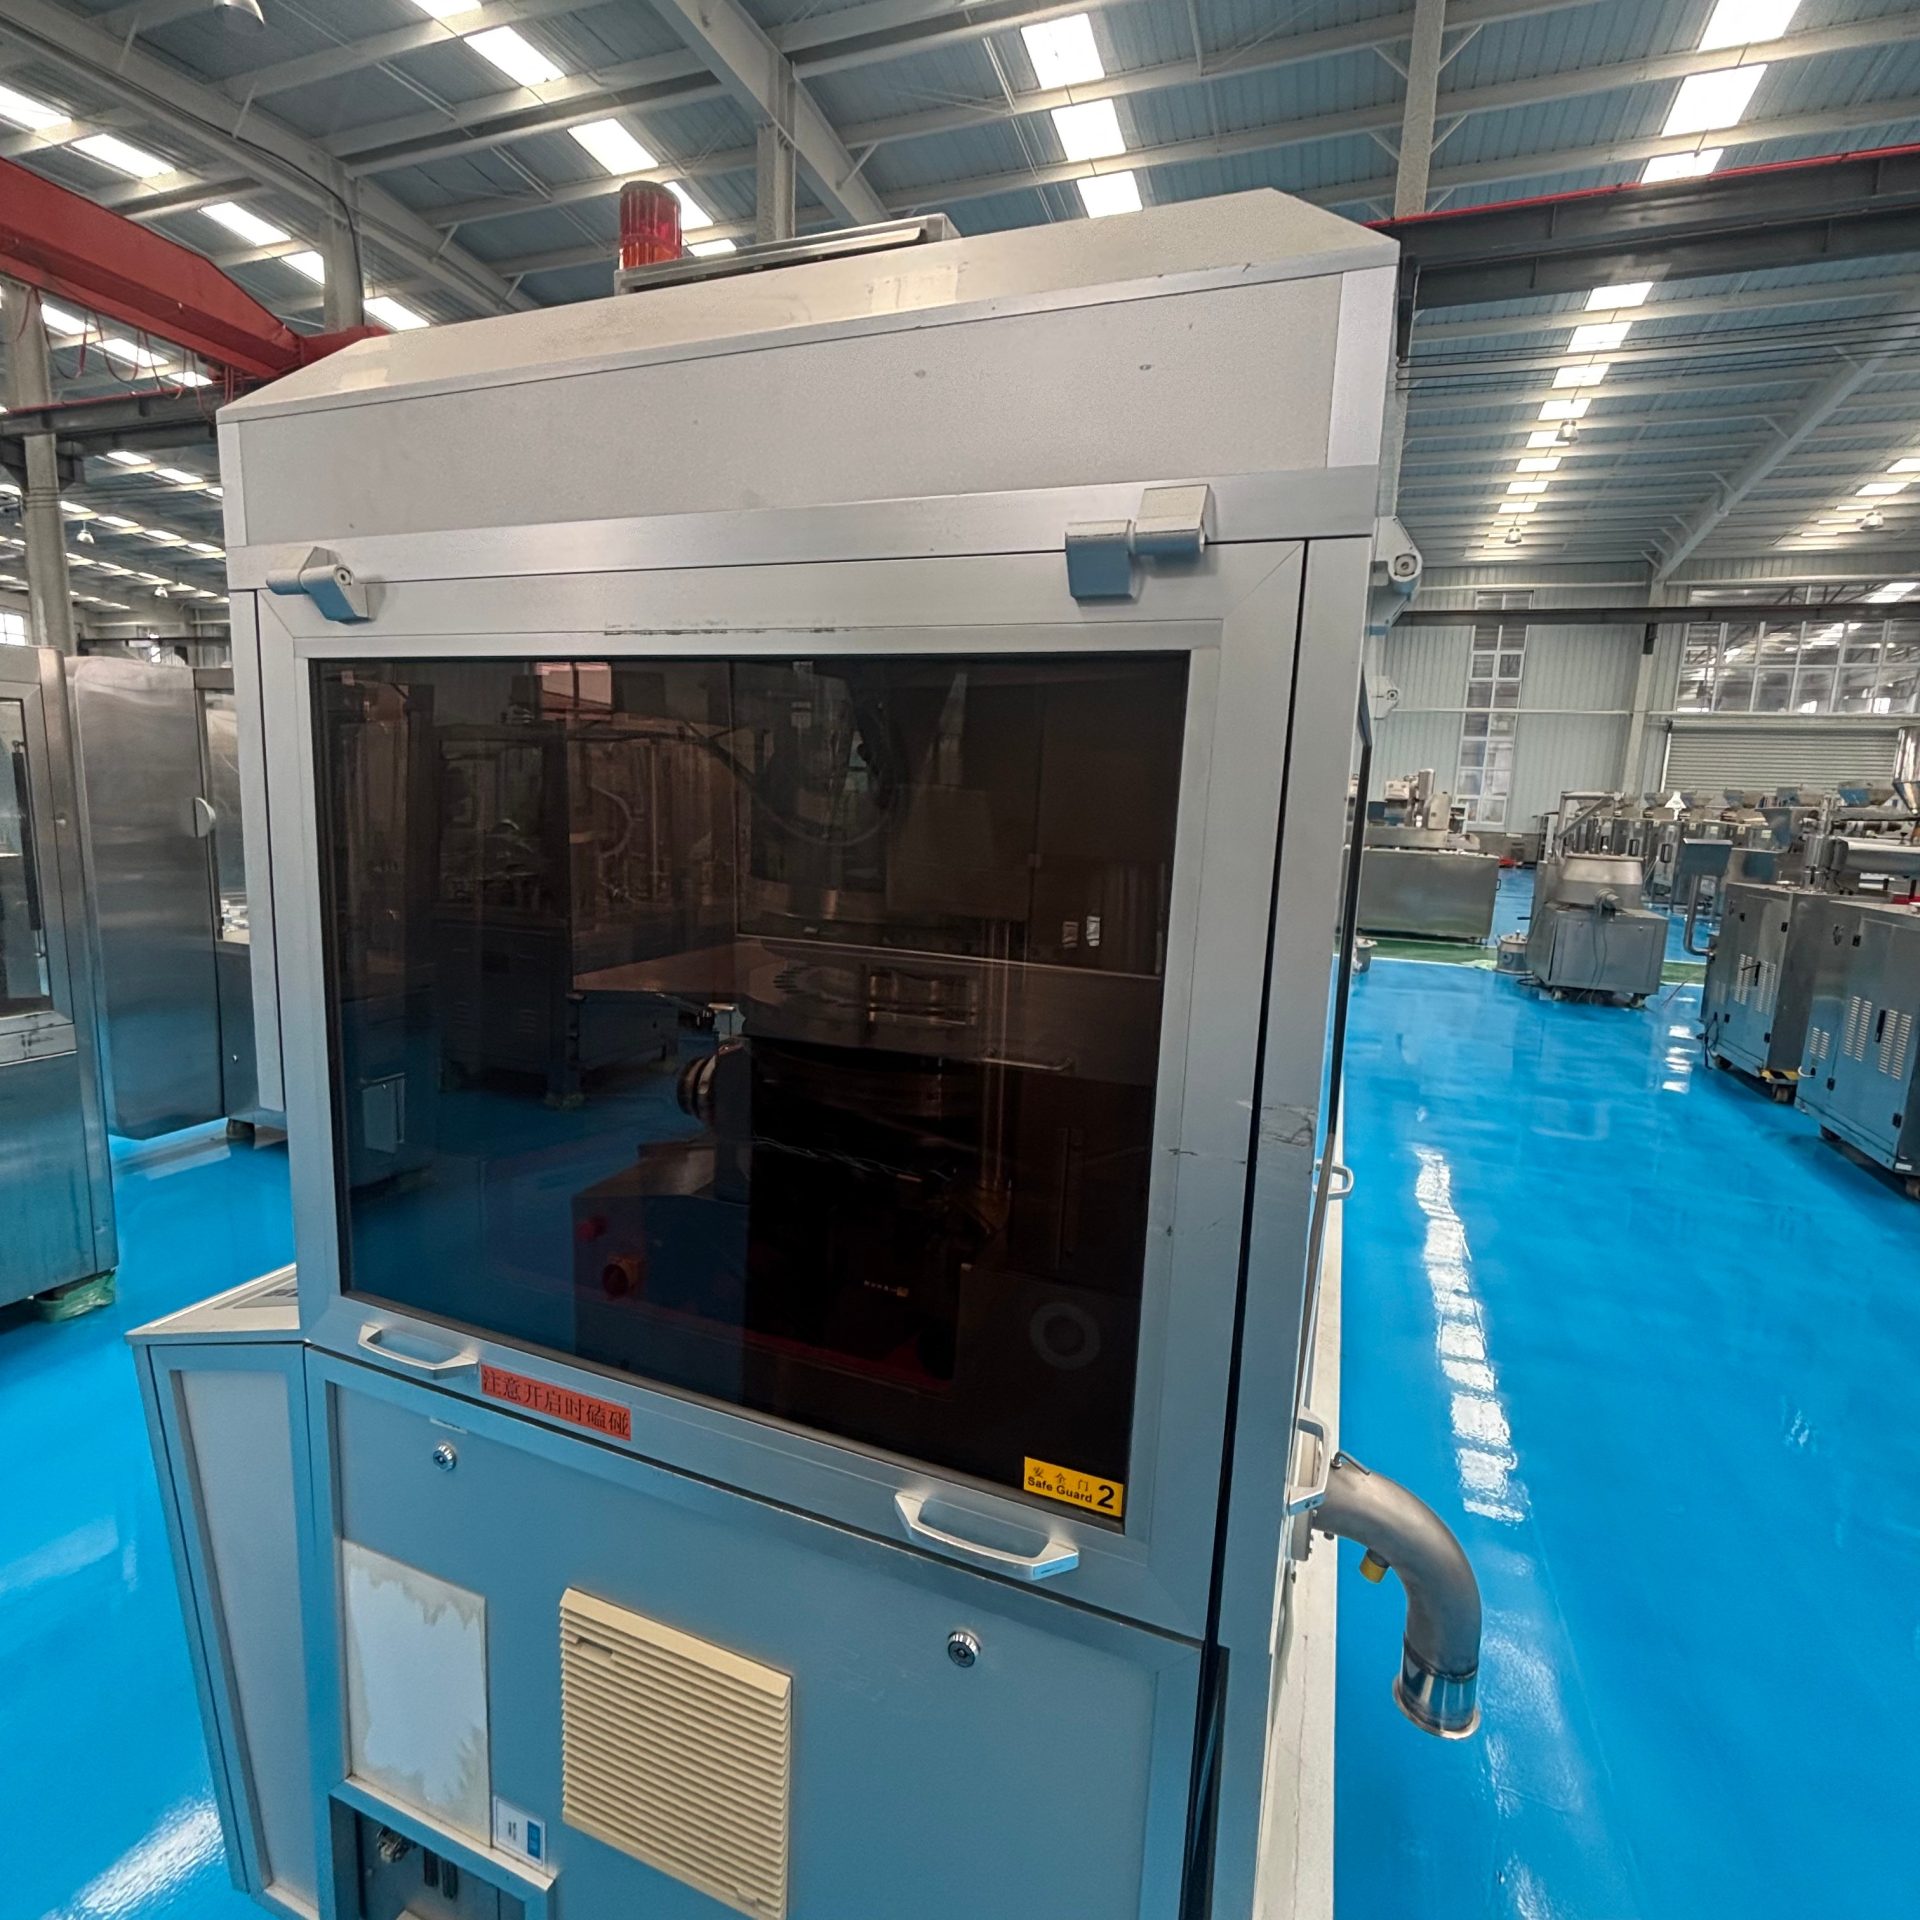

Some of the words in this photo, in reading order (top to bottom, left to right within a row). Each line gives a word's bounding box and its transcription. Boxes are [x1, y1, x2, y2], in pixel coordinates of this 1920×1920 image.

[484, 1370, 630, 1436] 注意开启时磕碰
[1027, 1476, 1053, 1491] Safe
[1056, 1485, 1092, 1503] Guard
[1097, 1484, 1115, 1510] 2
